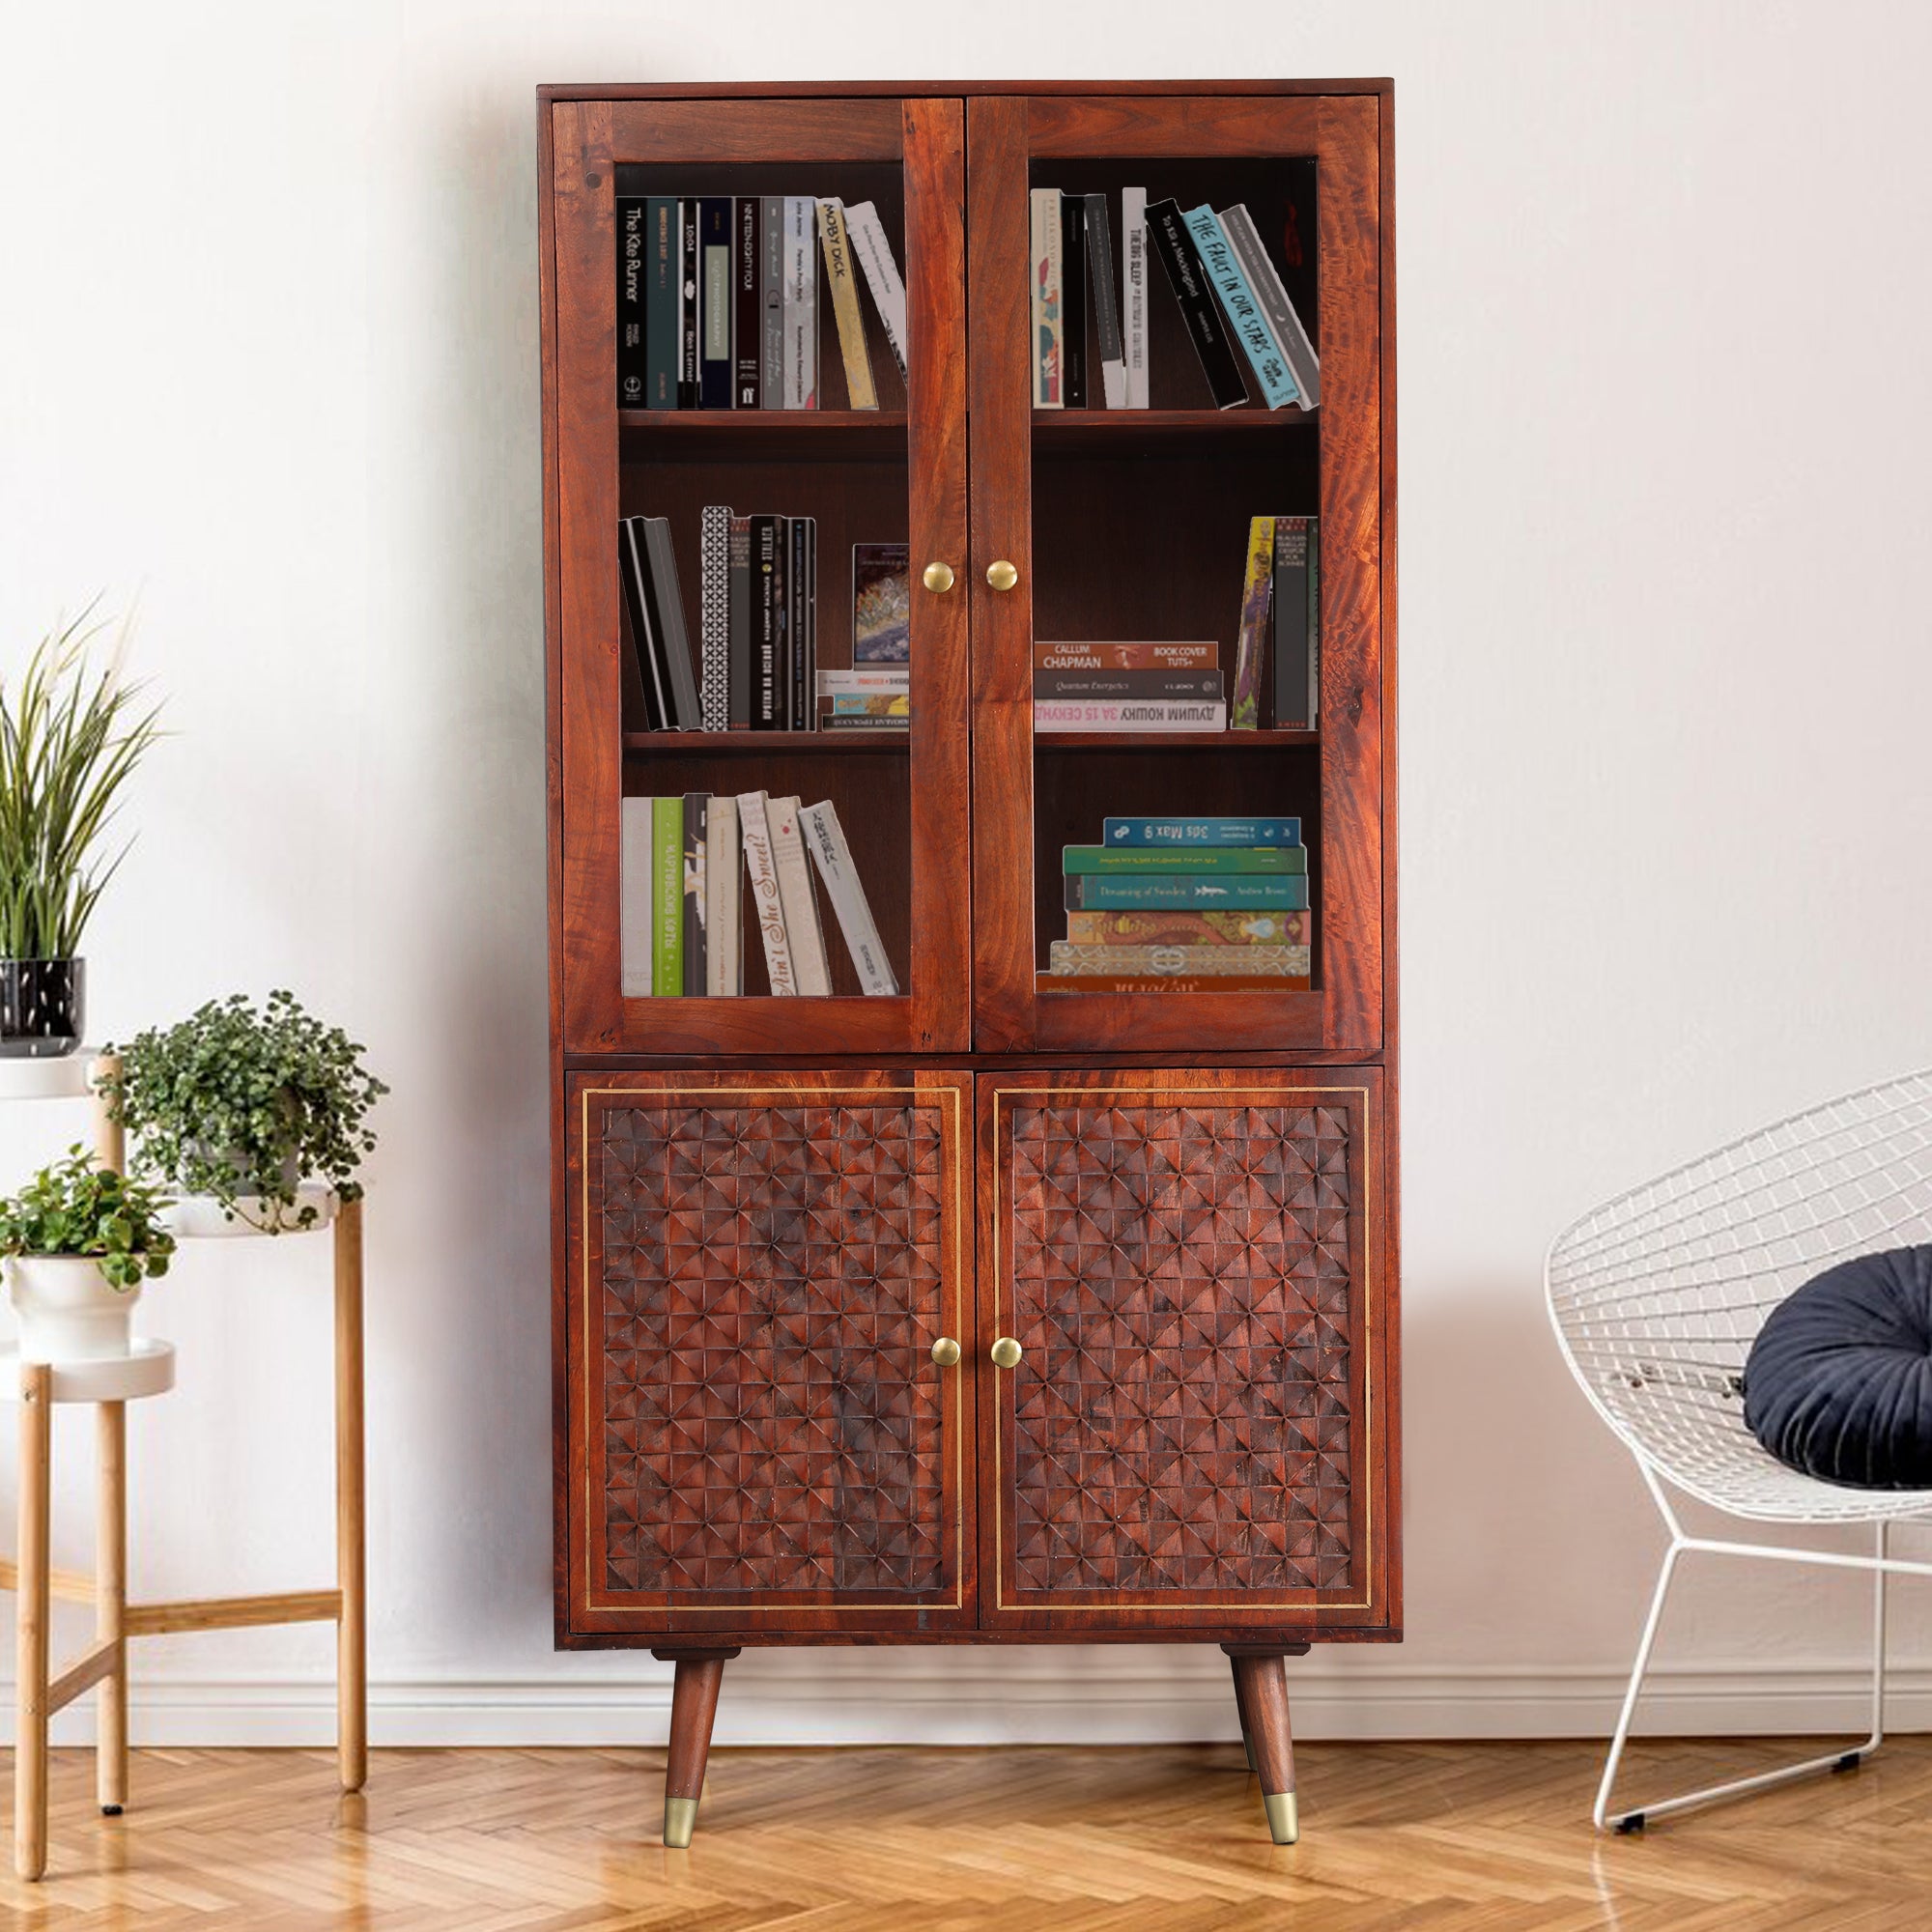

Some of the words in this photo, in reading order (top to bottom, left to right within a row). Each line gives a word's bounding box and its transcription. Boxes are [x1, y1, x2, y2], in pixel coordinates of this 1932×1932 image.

[626, 207, 641, 232] The
[823, 203, 840, 246] MOBY
[626, 233, 641, 258] Kite
[686, 224, 695, 252] 10:04
[831, 247, 846, 277] DICK
[1162, 214, 1173, 230] To
[1174, 246, 1200, 298] Mockingbird
[626, 260, 641, 303] Runner
[1130, 260, 1142, 286] SLEEP
[1191, 214, 1217, 240] THE
[1205, 242, 1232, 274] FAULT
[1219, 275, 1241, 293] IN
[1231, 294, 1254, 319] OUR
[1243, 320, 1271, 355] STARS
[686, 330, 695, 351] Ben
[686, 352, 695, 384] Lerner
[1054, 644, 1091, 655] CALLUM
[1153, 647, 1178, 657] BOOK
[1179, 647, 1208, 657] COVER
[1043, 656, 1101, 669] CHAPMAN
[1167, 657, 1194, 668] TUTS+
[1035, 706, 1082, 721] СЕКУНД
[1085, 707, 1098, 721] 15
[1101, 707, 1119, 721] ЗА
[1120, 707, 1165, 721] КОШКУ
[1168, 706, 1216, 722] ДУШИМ
[1155, 825, 1183, 838] Max
[1185, 825, 1208, 838] 3ds
[746, 833, 777, 898] Sweet?
[761, 904, 784, 944] She
